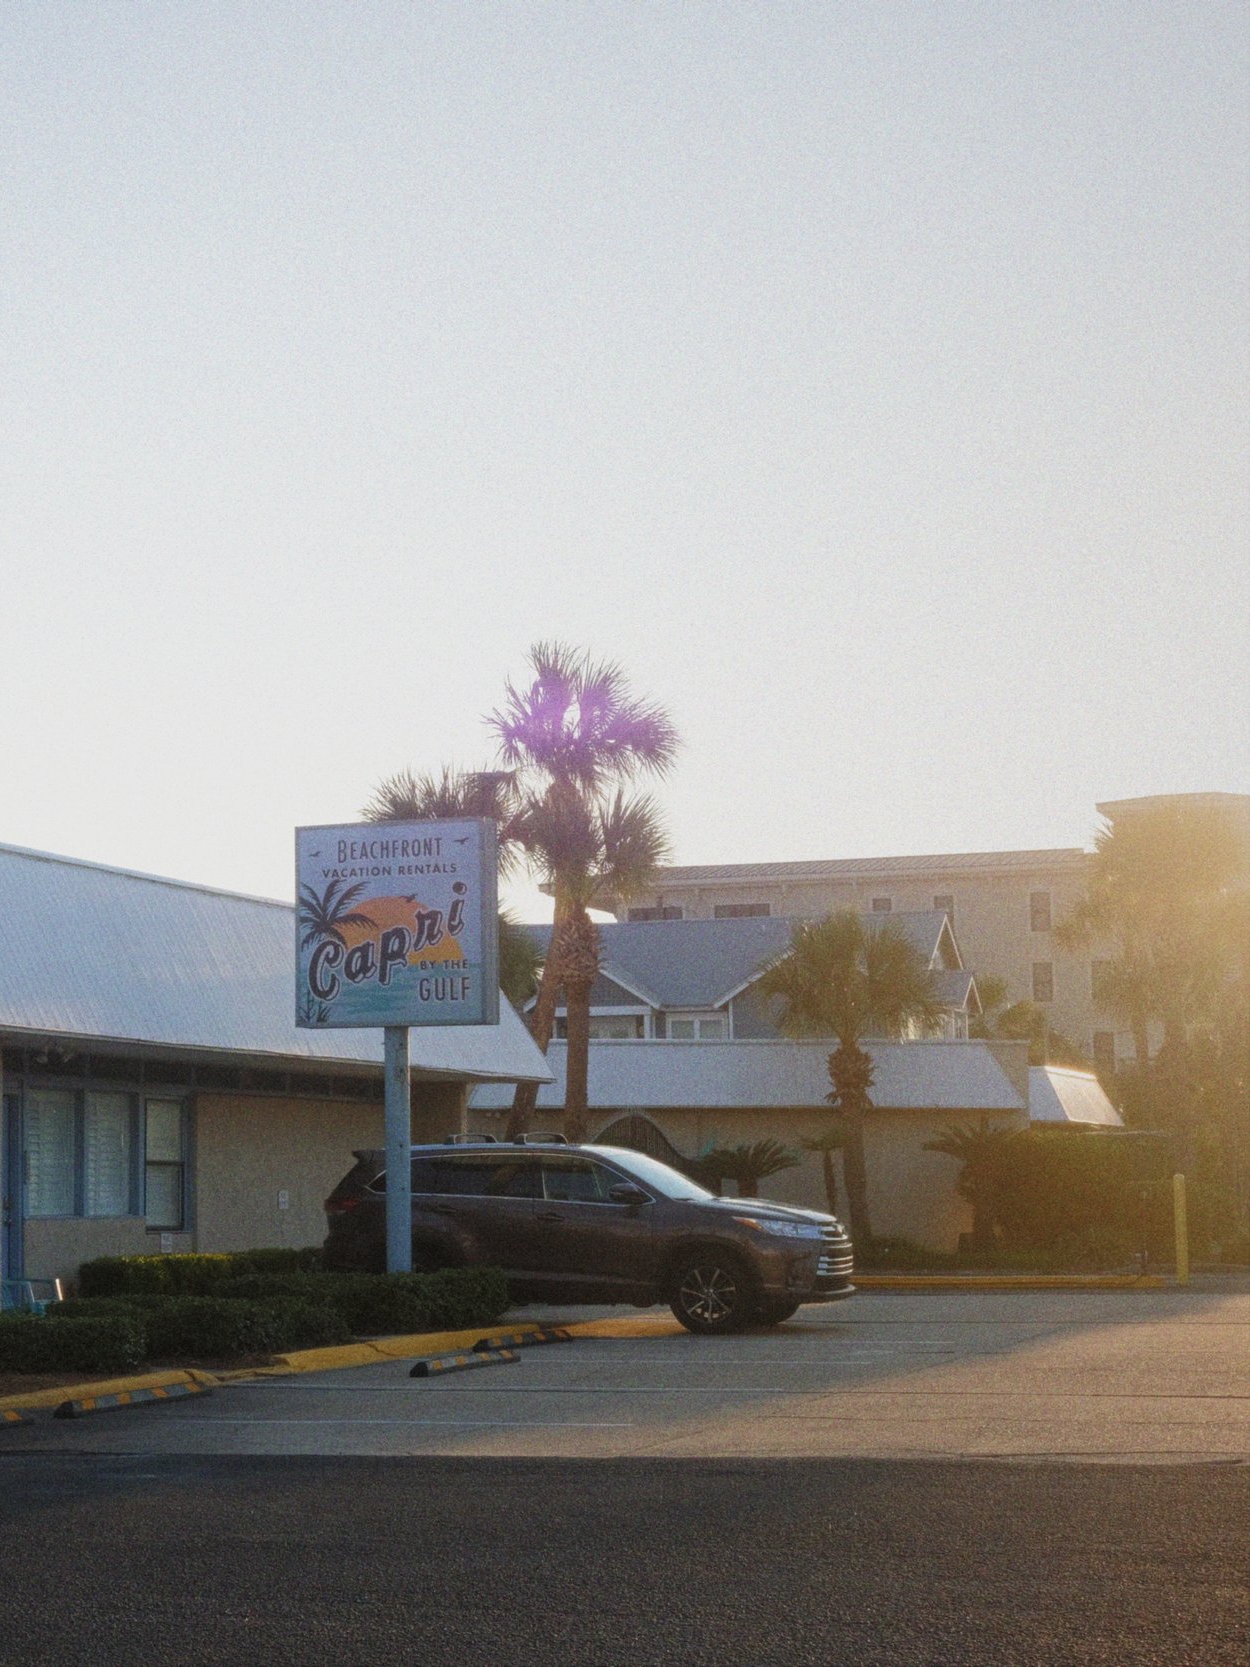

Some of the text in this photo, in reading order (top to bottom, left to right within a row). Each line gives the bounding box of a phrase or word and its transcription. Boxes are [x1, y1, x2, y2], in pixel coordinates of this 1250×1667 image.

[337, 837, 442, 863] BEACHFRONT
[322, 864, 457, 879] VACATION RENTALS
[308, 881, 468, 1000] Capri
[419, 959, 469, 970] BY THE
[419, 976, 470, 1001] GULF
